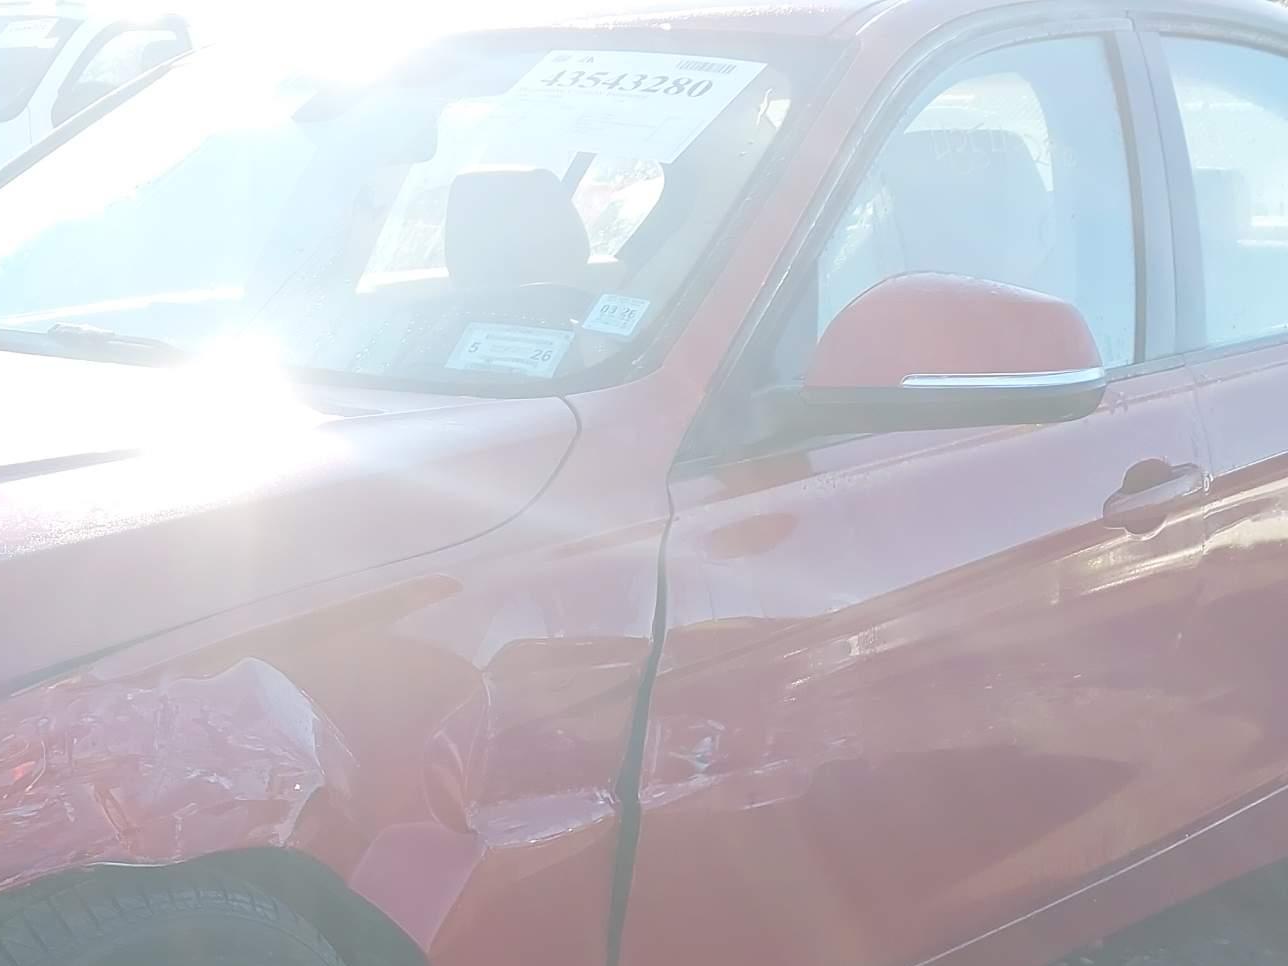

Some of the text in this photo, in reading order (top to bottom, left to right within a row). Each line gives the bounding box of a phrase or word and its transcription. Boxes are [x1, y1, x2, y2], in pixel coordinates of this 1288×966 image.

[540, 70, 714, 97] 43543280
[468, 341, 482, 353] 5
[530, 348, 553, 363] 26
